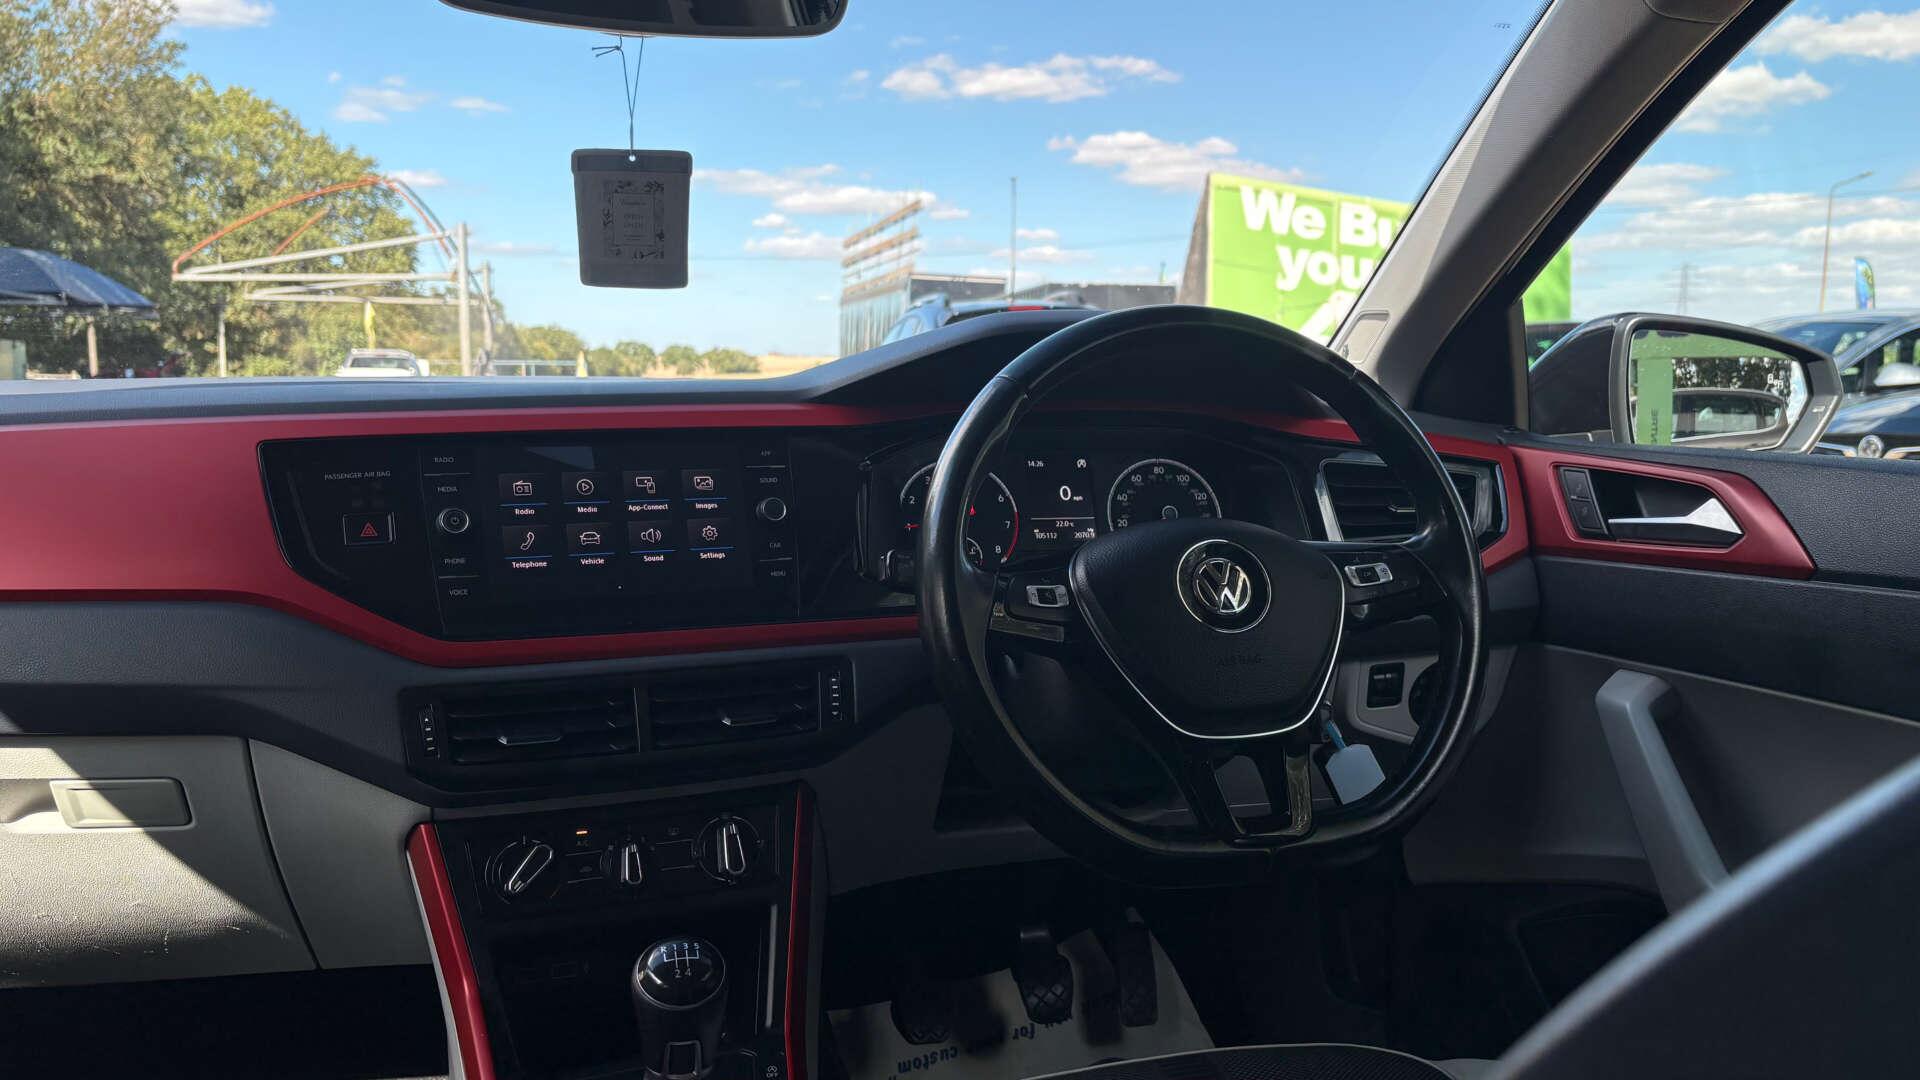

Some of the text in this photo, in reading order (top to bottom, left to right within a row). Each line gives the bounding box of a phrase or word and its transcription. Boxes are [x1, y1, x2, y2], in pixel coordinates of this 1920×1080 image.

[1239, 185, 1326, 240] We
[1276, 244, 1380, 292] you
[1153, 466, 1165, 475] 80
[324, 472, 363, 481] PASSENGER
[1131, 474, 1142, 482] 60
[1175, 474, 1190, 482] 100
[1059, 485, 1072, 501] 0
[1117, 493, 1128, 502] 40
[909, 496, 915, 504] 2
[998, 495, 1005, 503] 6
[577, 505, 598, 514] Media
[628, 502, 669, 512] App-Connect
[695, 501, 718, 511] Images
[514, 507, 535, 516] Radio
[1005, 520, 1011, 529] 7
[1117, 519, 1128, 527] 20
[995, 545, 1002, 554] 8
[643, 554, 664, 563] Sound
[700, 551, 726, 561] Settings
[512, 560, 548, 569] Telephone
[580, 557, 605, 566] Vehicle
[674, 967, 691, 978] 2 4
[897, 1046, 959, 1073] custom
